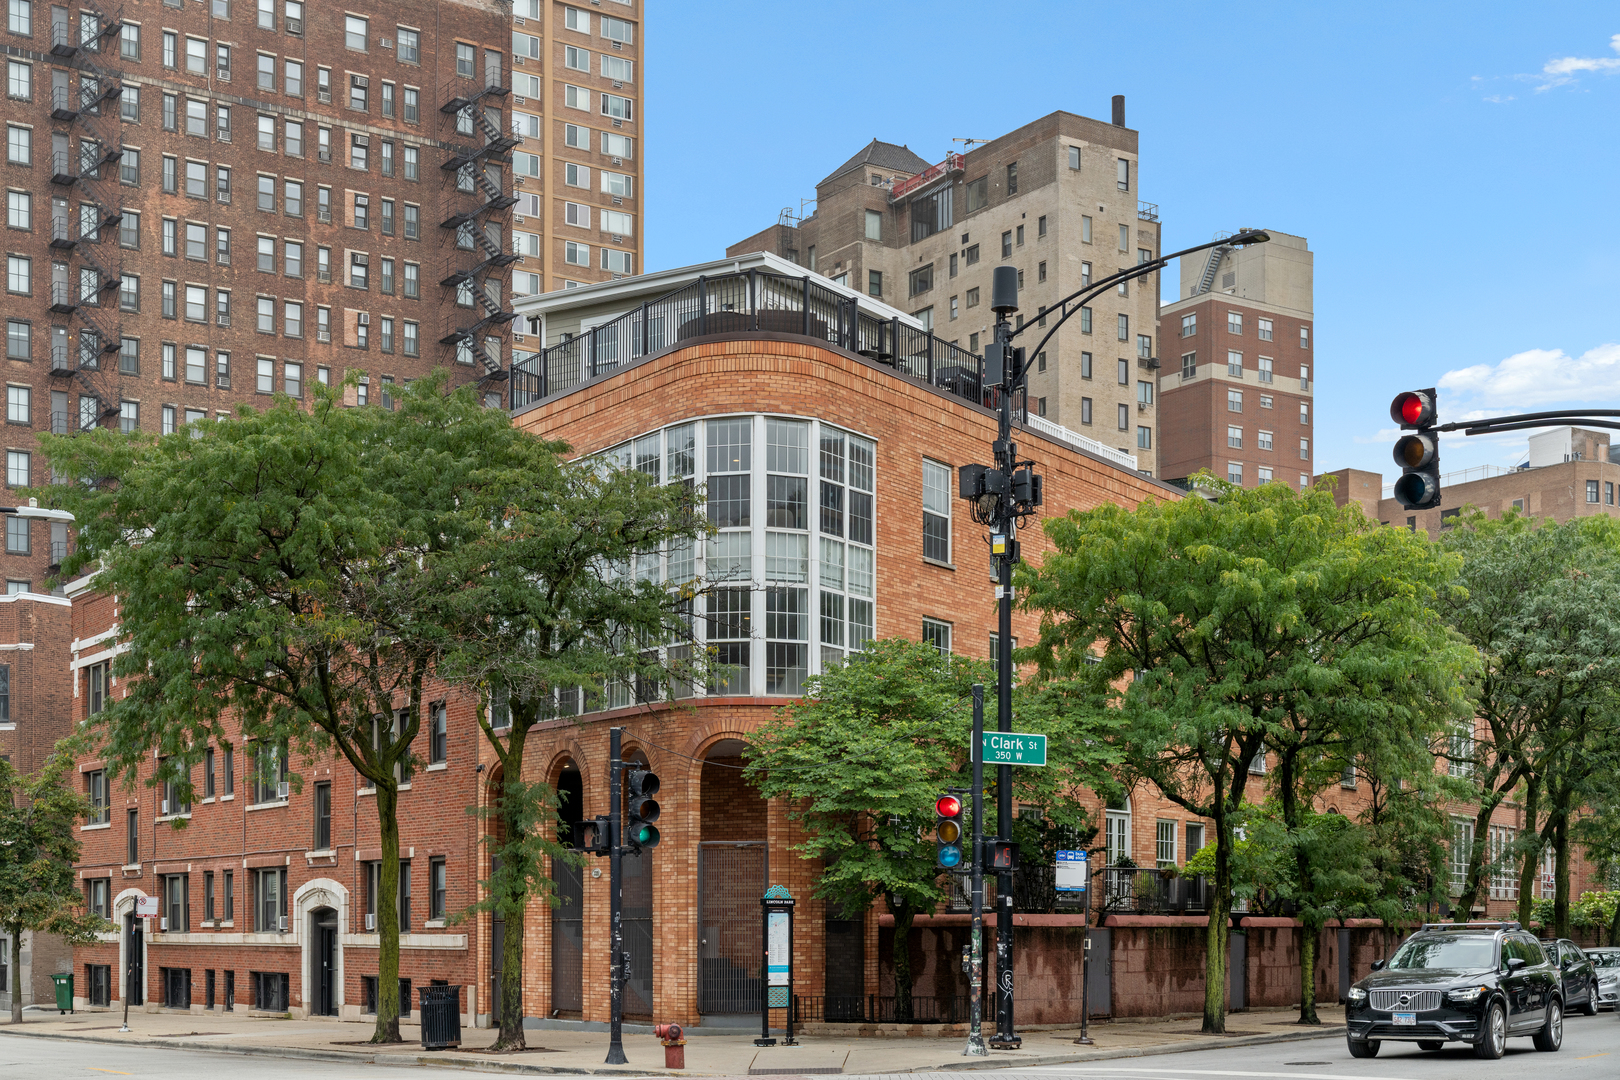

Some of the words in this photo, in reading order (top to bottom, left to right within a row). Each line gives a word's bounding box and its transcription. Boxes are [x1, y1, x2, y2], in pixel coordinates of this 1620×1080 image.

[991, 736, 1024, 750] Clark
[1028, 741, 1037, 750] St
[995, 751, 1011, 760] 350
[1016, 752, 1023, 760] W
